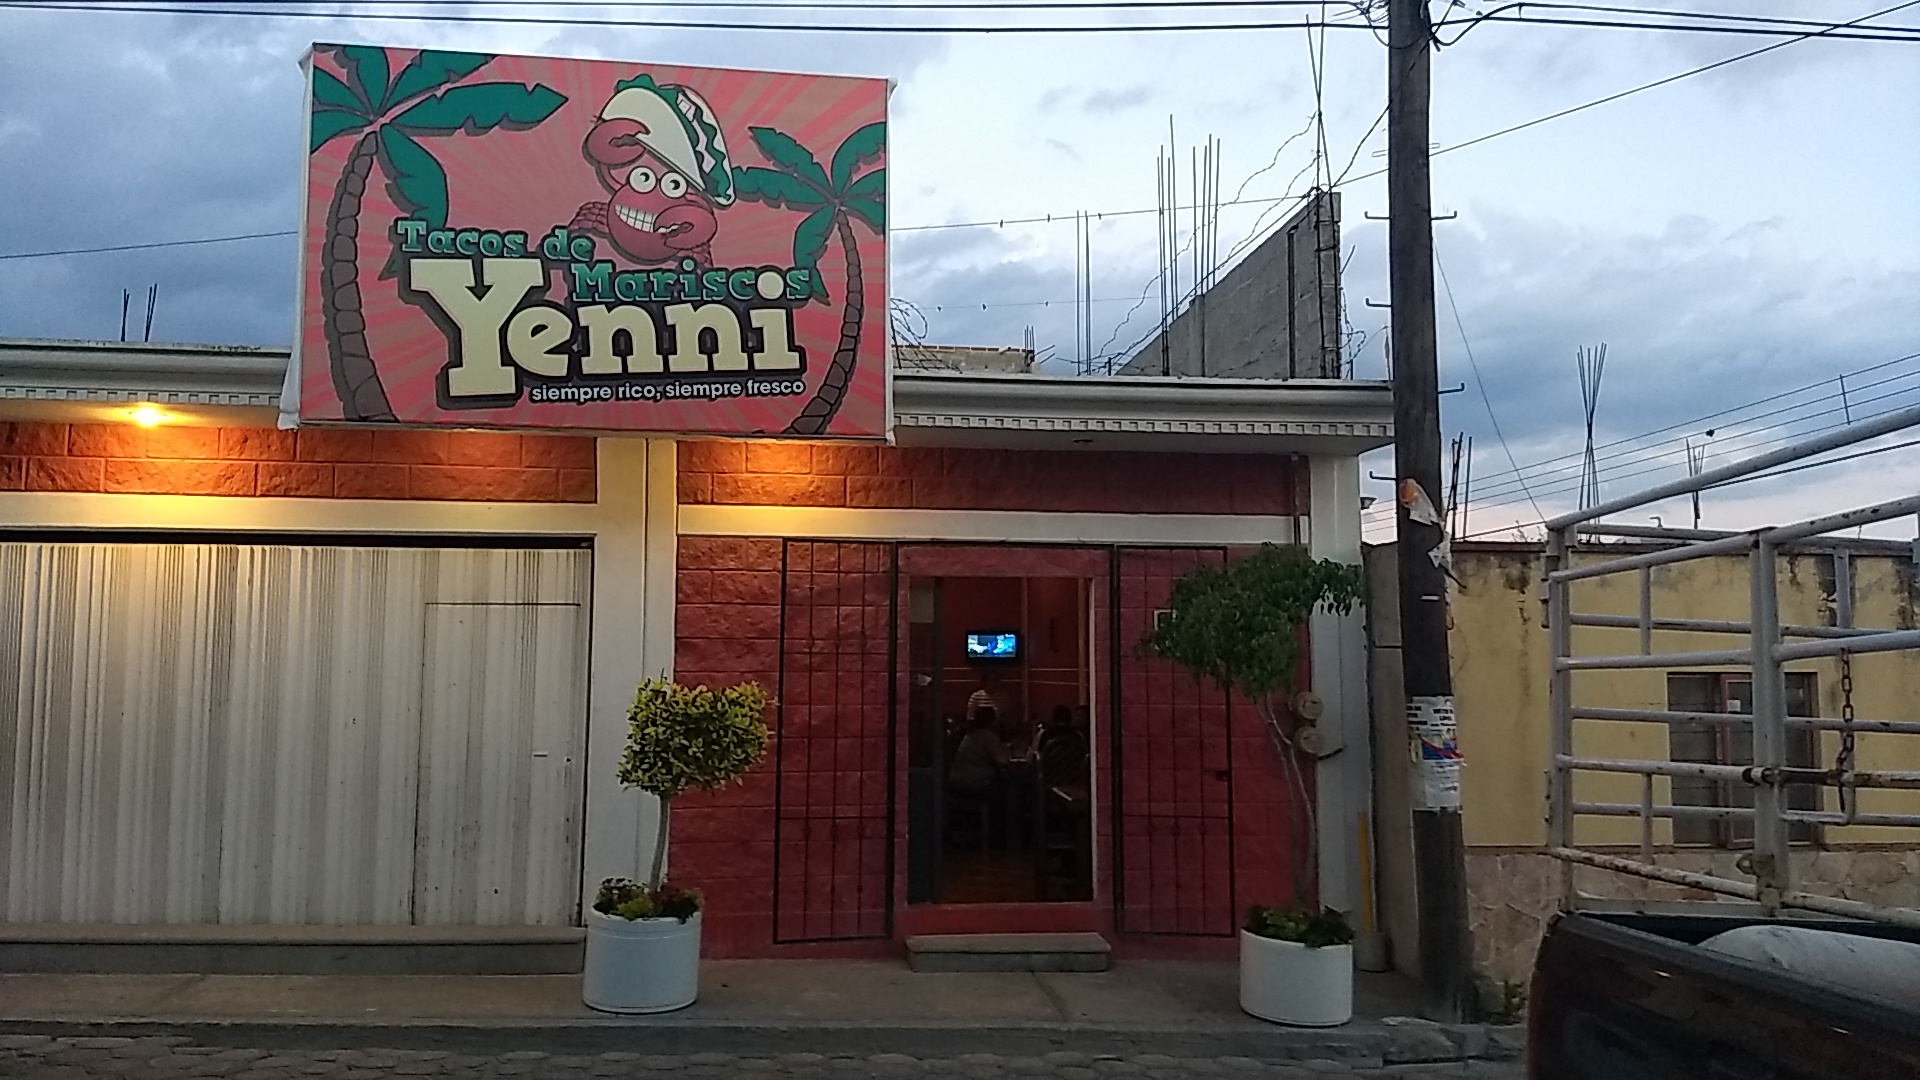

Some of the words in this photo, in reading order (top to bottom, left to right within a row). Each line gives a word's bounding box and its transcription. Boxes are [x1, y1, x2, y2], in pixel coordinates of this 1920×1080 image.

[397, 220, 524, 257] Tacos
[543, 229, 594, 261] de
[571, 260, 812, 302] Mariscos
[410, 258, 801, 397] Yenni
[532, 384, 612, 402] siempre
[617, 383, 661, 400] rico,
[665, 381, 742, 399] siempre
[747, 379, 805, 395] fresco
